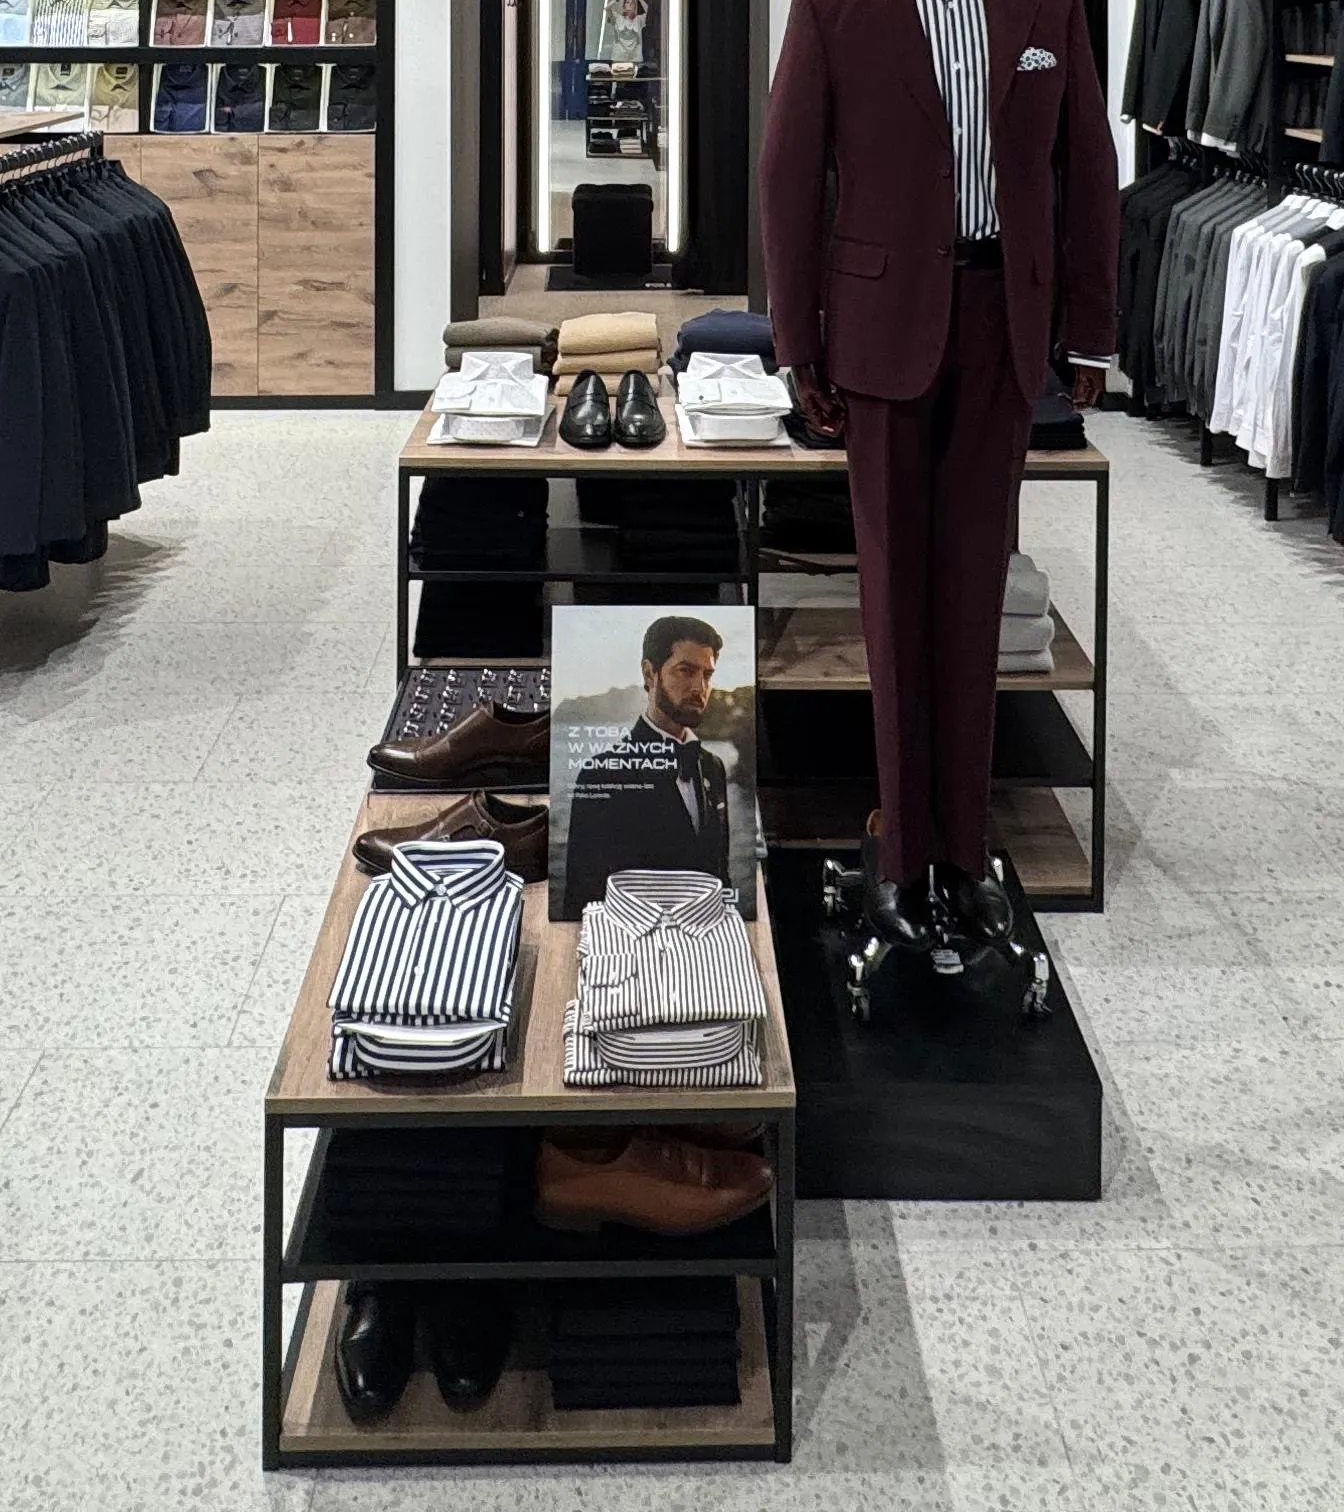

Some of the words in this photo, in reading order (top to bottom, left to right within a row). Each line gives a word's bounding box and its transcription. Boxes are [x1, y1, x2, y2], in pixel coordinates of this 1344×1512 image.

[568, 726, 580, 738] Z
[568, 741, 584, 754] W
[568, 757, 678, 770] MOMENTACH
